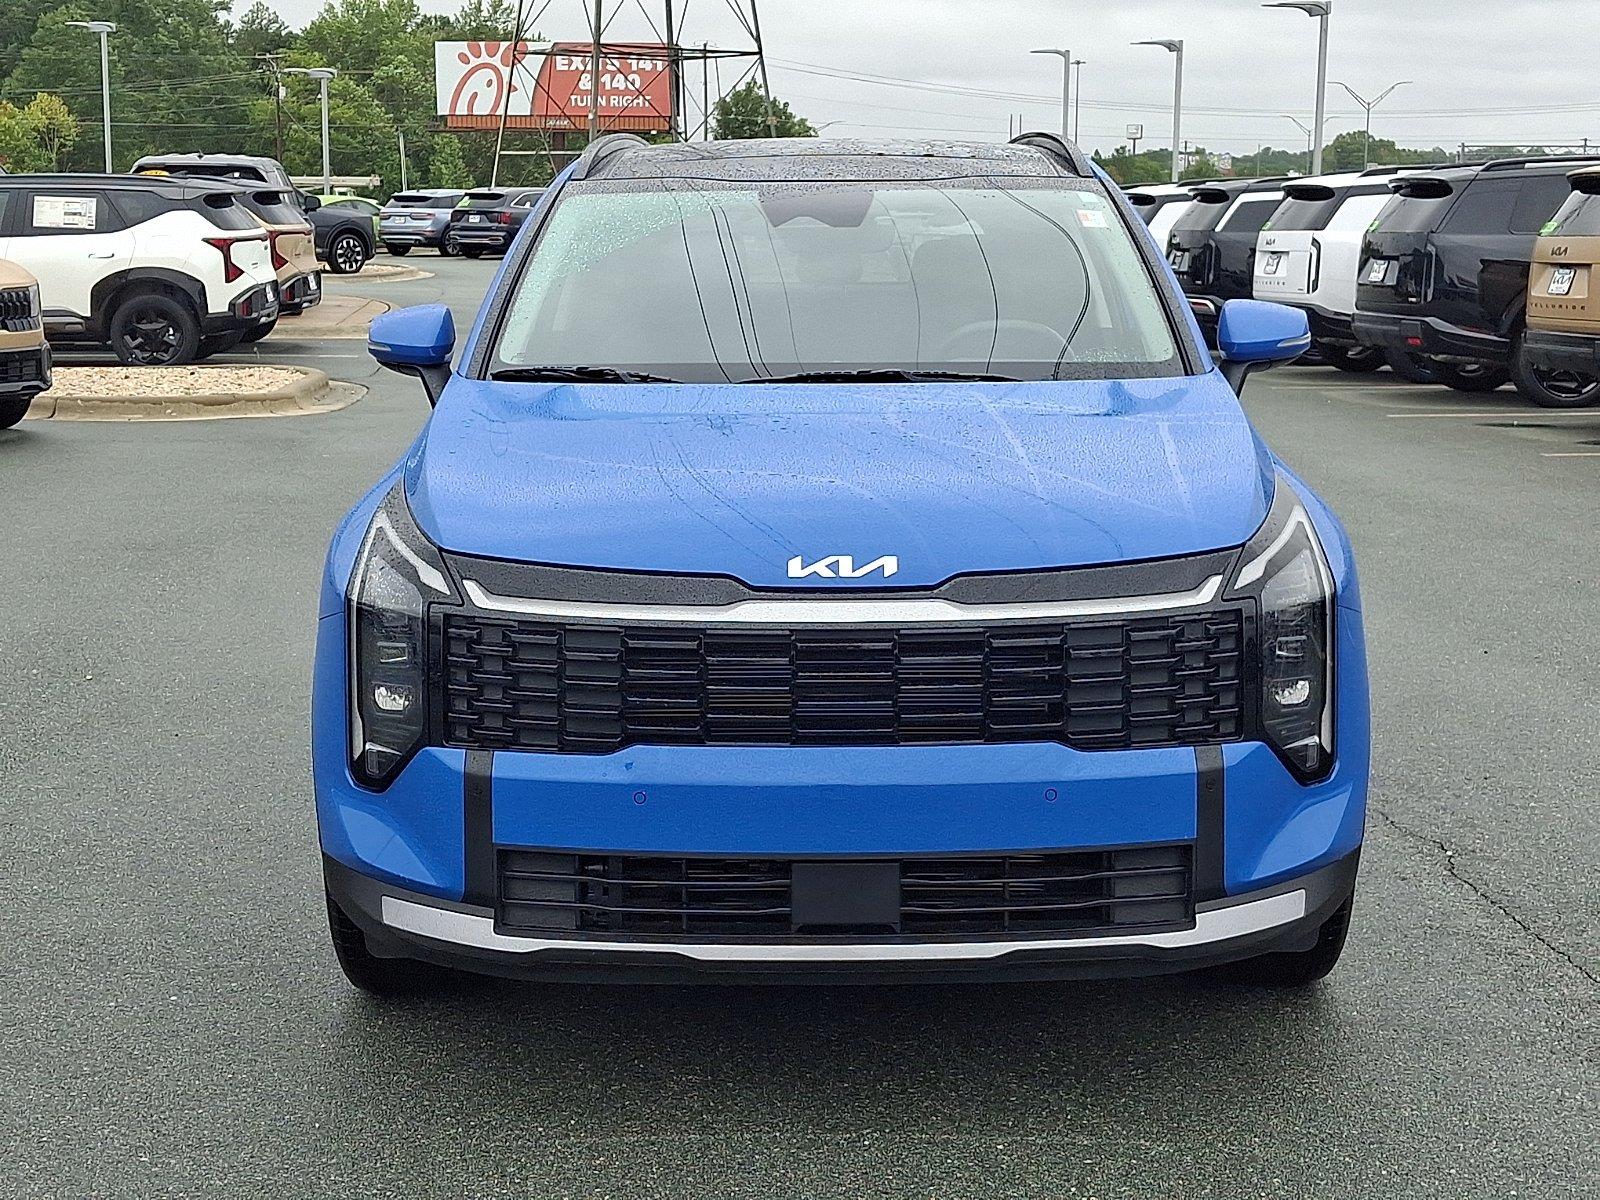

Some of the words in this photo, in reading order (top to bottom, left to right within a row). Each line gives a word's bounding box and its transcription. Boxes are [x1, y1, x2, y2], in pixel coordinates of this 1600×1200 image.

[626, 54, 663, 72] 141
[579, 73, 593, 90] &
[601, 73, 641, 91] 140
[610, 95, 652, 108] RIGHT
[1550, 246, 1569, 256] KIA
[787, 555, 898, 578] KIA
